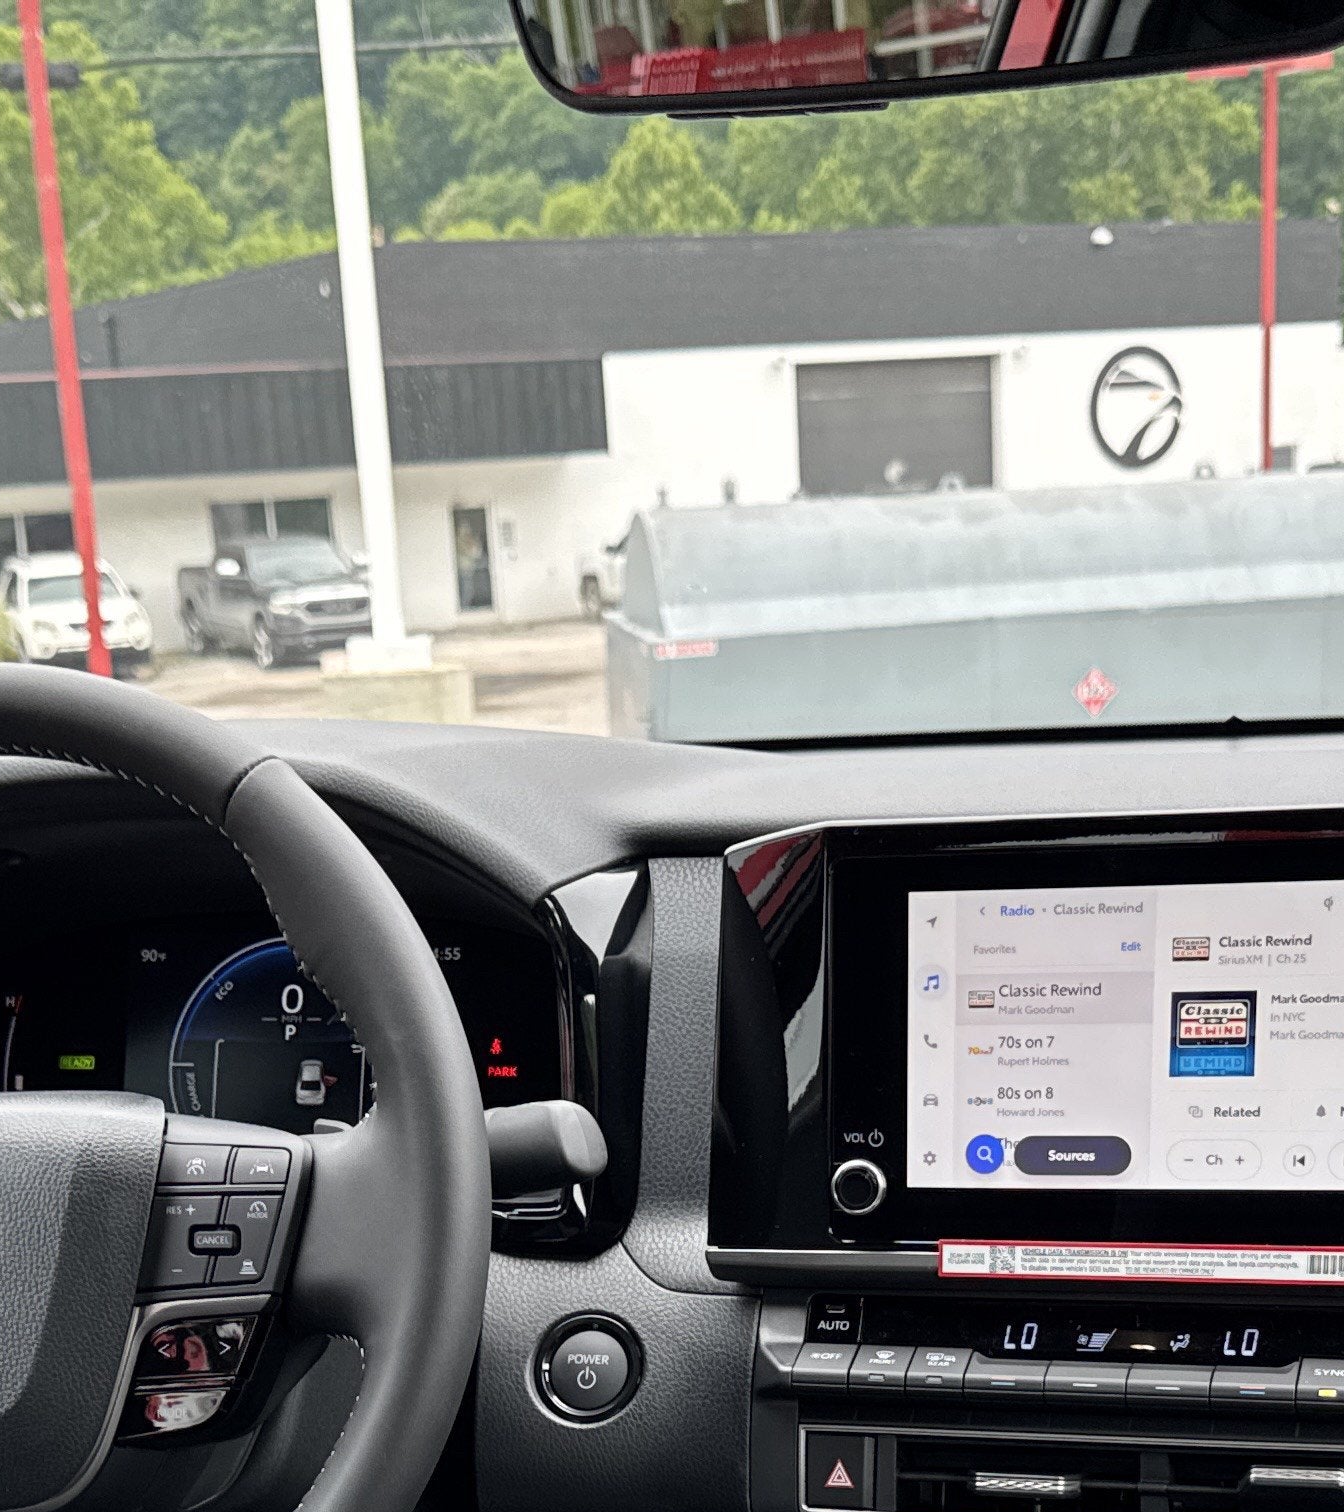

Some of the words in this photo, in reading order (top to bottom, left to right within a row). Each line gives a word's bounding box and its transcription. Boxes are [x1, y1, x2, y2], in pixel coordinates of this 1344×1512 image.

[1000, 905, 1035, 917] Radio
[1053, 903, 1095, 916] Classic
[1098, 902, 1144, 914] Rewind
[1120, 941, 1142, 952] Edit
[1218, 936, 1263, 948] Classic
[1265, 934, 1313, 947] Rewind
[973, 944, 1017, 955] Favorites
[1218, 955, 1262, 966] SiriusXM
[1276, 954, 1290, 964] Ch
[1291, 954, 1306, 964] 25
[215, 980, 235, 1001] ECO
[998, 983, 1047, 997] Classic
[1050, 982, 1102, 997] Rewind
[281, 984, 304, 1015] 0
[1271, 994, 1298, 1004] Mark
[998, 1005, 1022, 1015] Mark
[1024, 1004, 1075, 1015] Goodman
[1184, 1005, 1244, 1016] Classic
[1283, 1012, 1306, 1022] NYC
[284, 1025, 298, 1042] P
[1184, 1026, 1243, 1036] REWIND
[1269, 1030, 1295, 1040] Mark
[998, 1036, 1022, 1049] 70s
[1024, 1039, 1043, 1049] on
[1046, 1035, 1055, 1048] 7
[997, 1056, 1030, 1067] Rupert
[1032, 1056, 1069, 1066] Holmes
[488, 1066, 519, 1078] PARK
[997, 1087, 1021, 1100] 80s
[1024, 1089, 1042, 1099] on
[1045, 1087, 1054, 1099] 8
[997, 1107, 1035, 1117] Howard
[1037, 1107, 1065, 1118] Jones
[1213, 1106, 1261, 1118] Related
[844, 1132, 866, 1143] VOL
[1048, 1149, 1096, 1162] Sources
[1206, 1155, 1223, 1166] Ch
[196, 1235, 230, 1246] CANCEL
[817, 1320, 850, 1331] AUTO
[567, 1353, 610, 1366] POWER
[821, 1352, 843, 1361] OFF
